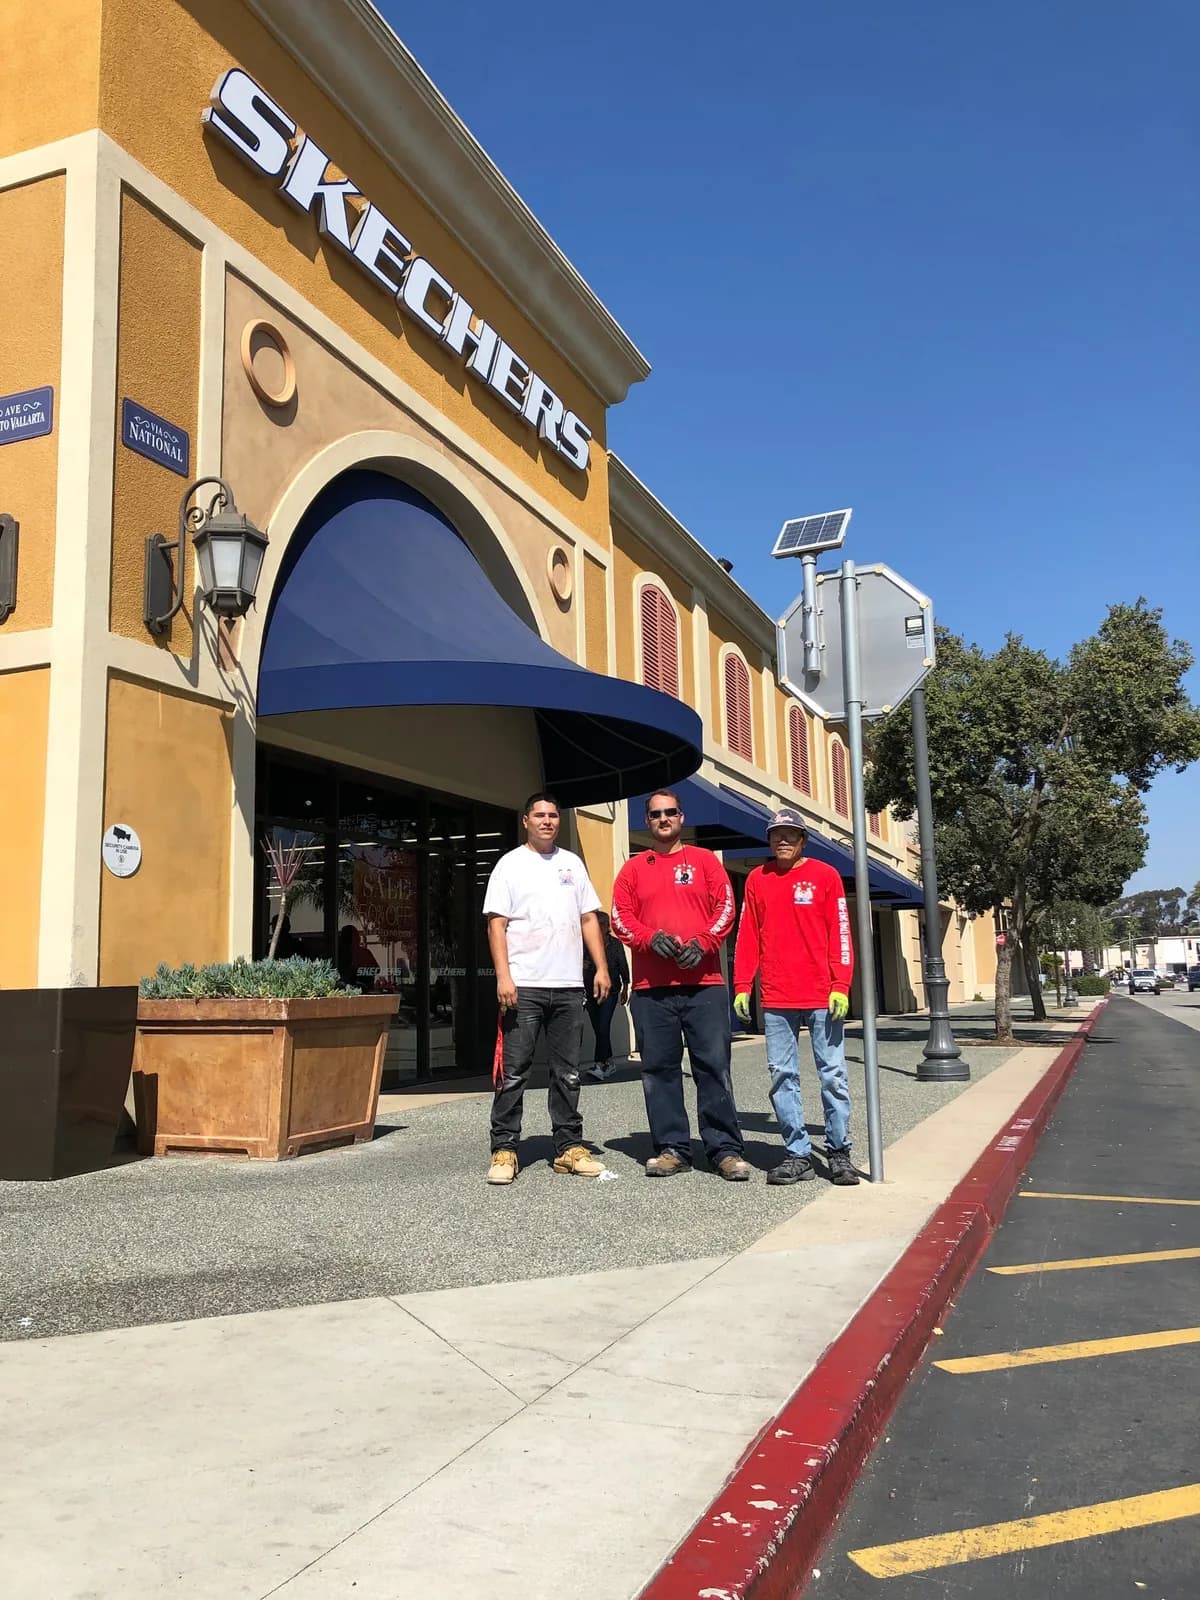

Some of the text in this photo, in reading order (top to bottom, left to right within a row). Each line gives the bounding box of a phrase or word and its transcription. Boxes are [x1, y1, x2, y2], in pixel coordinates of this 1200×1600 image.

[201, 68, 592, 471] SKECHERS
[4, 404, 21, 417] AVE
[10, 411, 45, 431] VALLARTA
[150, 423, 163, 437] VIA
[129, 421, 183, 463] NATIONAL
